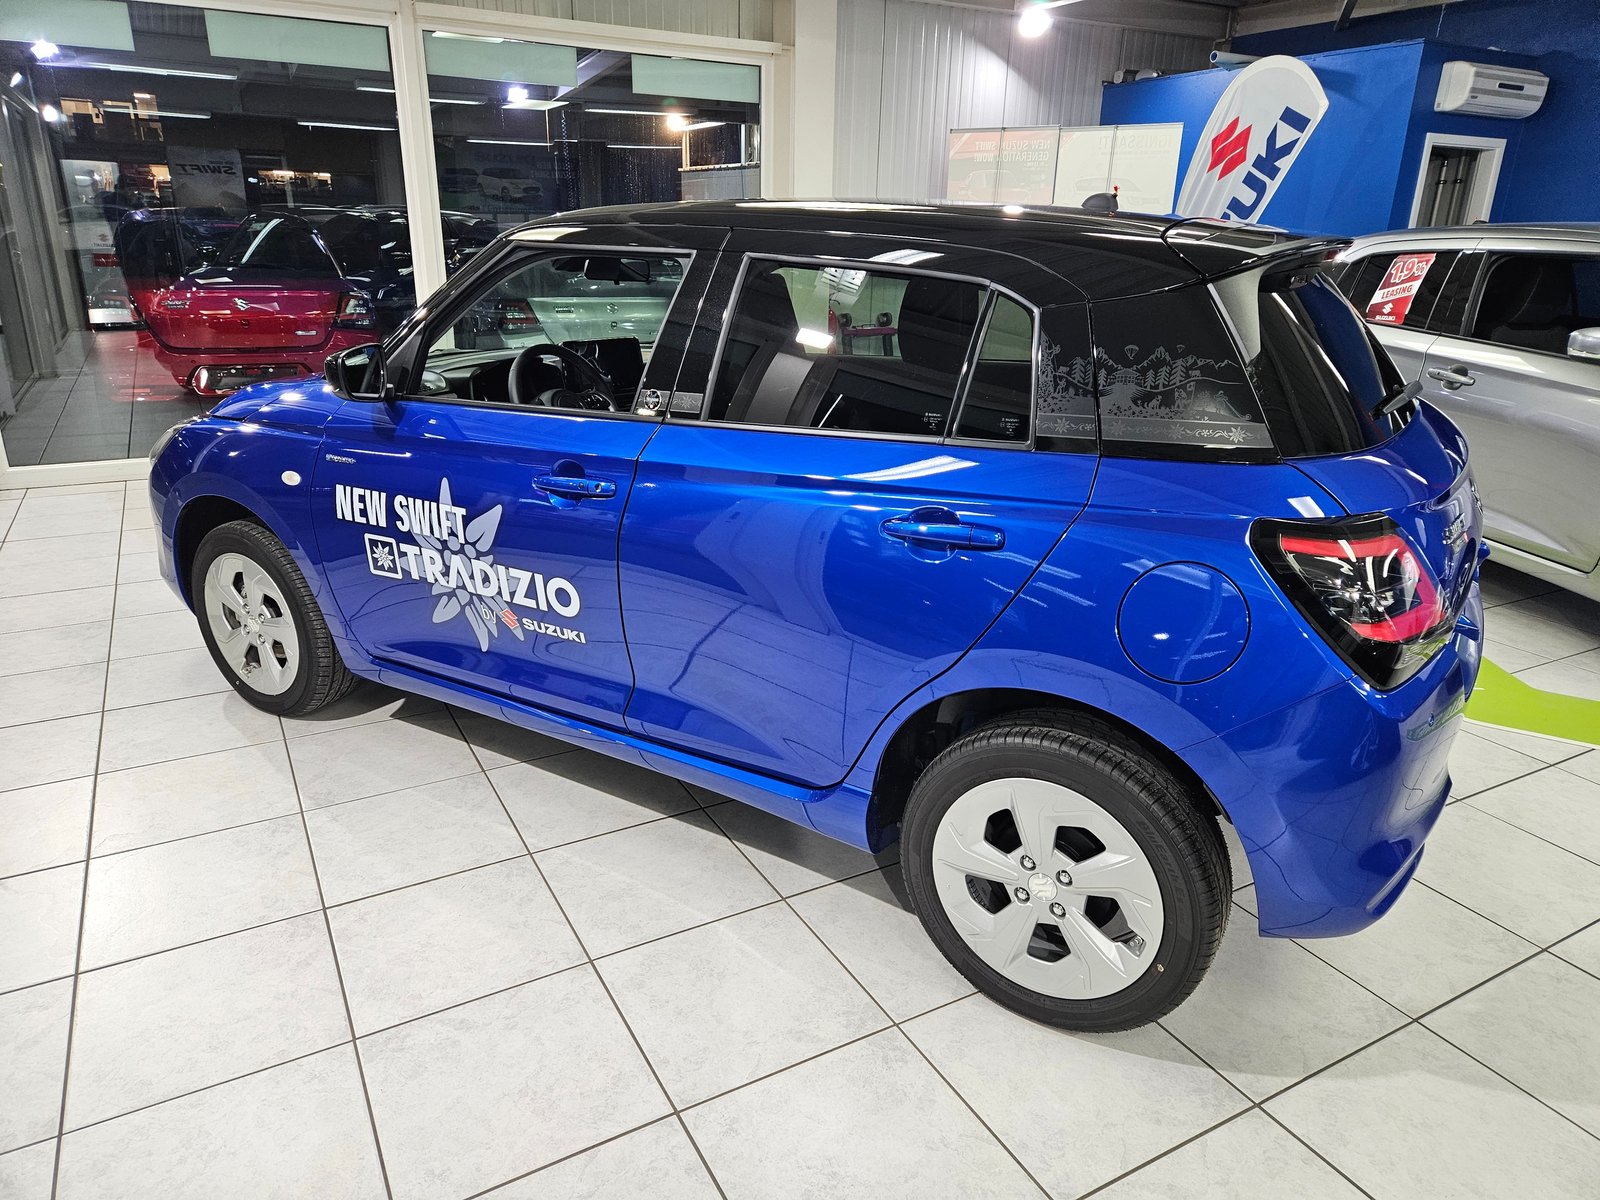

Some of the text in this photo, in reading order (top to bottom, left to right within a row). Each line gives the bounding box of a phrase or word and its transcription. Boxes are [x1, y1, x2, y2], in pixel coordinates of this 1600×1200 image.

[1220, 106, 1311, 220] UKI
[1381, 284, 1413, 299] LEASING
[335, 484, 467, 544] NEW SWIFT
[398, 542, 581, 618] TRADIZIO
[481, 604, 587, 644] by SUZUKI
